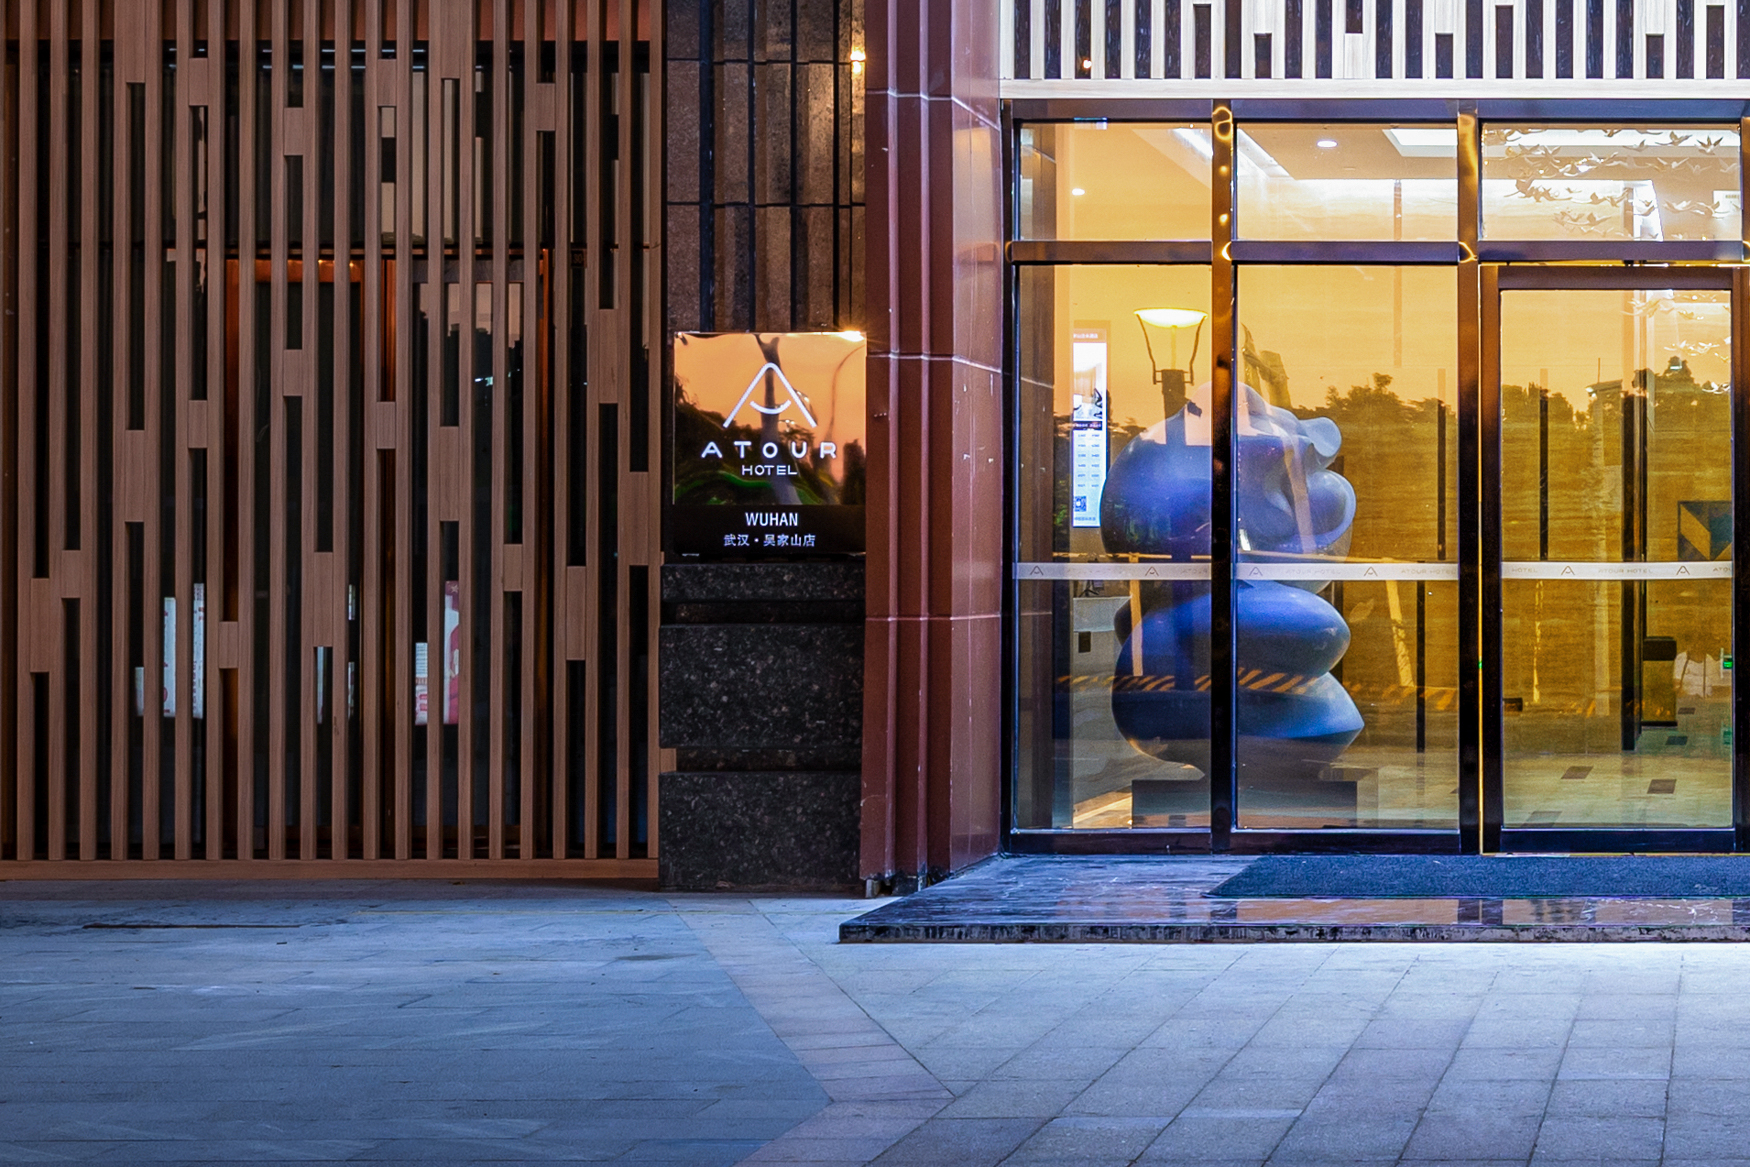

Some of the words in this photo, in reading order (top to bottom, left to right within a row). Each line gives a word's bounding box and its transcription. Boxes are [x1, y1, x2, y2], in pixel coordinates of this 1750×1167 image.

[701, 441, 837, 459] ATOUR
[741, 464, 798, 476] HOTEL
[745, 512, 798, 527] WUHAN
